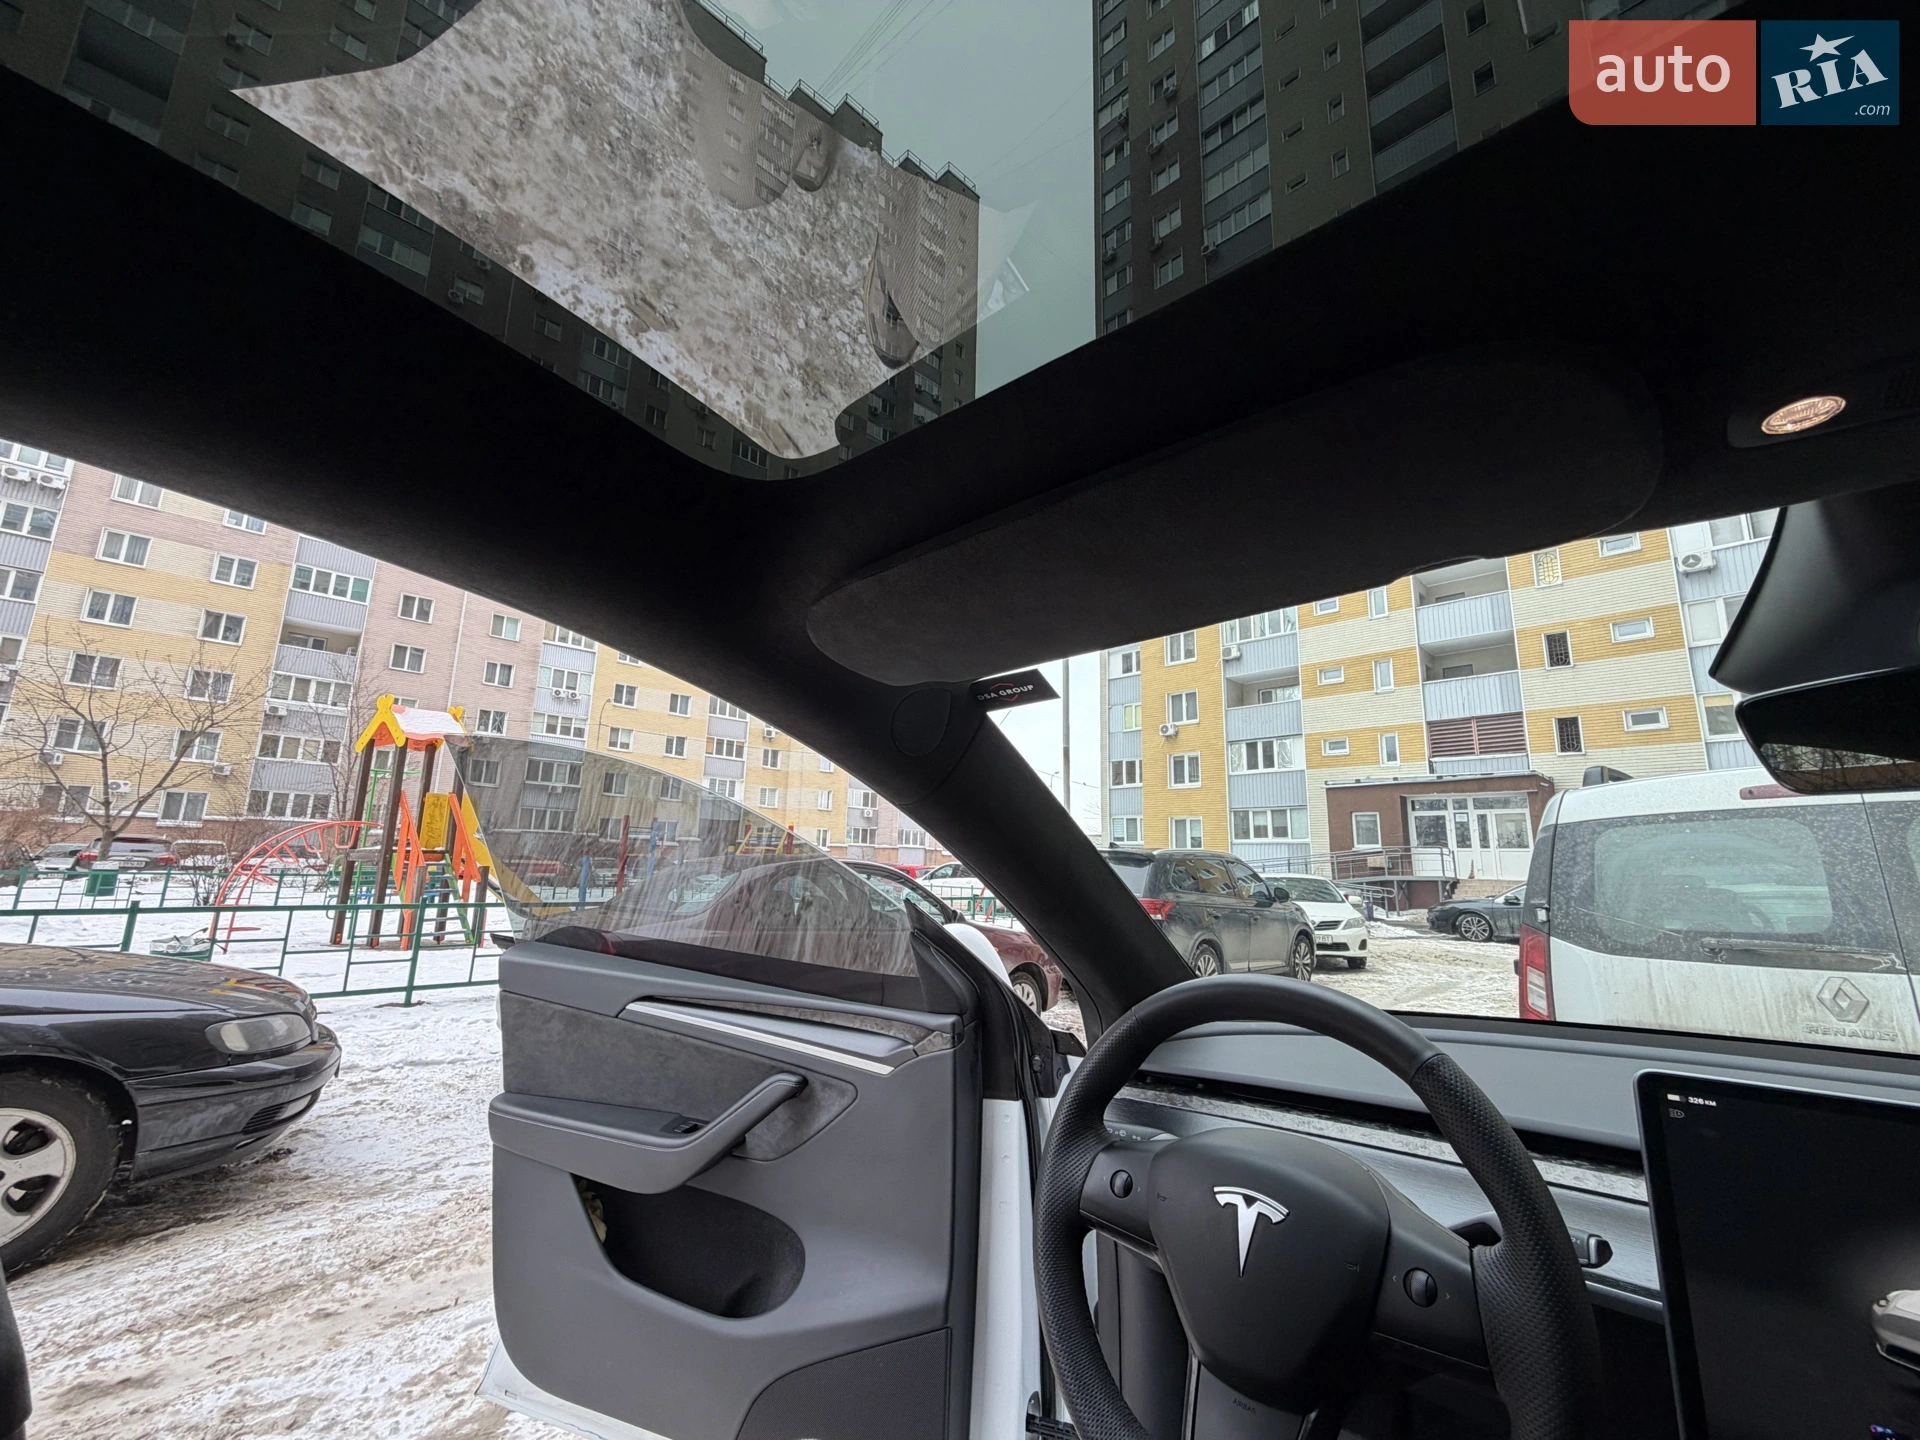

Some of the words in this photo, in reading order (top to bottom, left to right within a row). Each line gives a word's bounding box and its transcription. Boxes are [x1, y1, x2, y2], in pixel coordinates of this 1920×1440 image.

[976, 692, 998, 701] DSA
[999, 684, 1034, 696] GROUP
[1803, 1023, 1899, 1041] RENAULT
